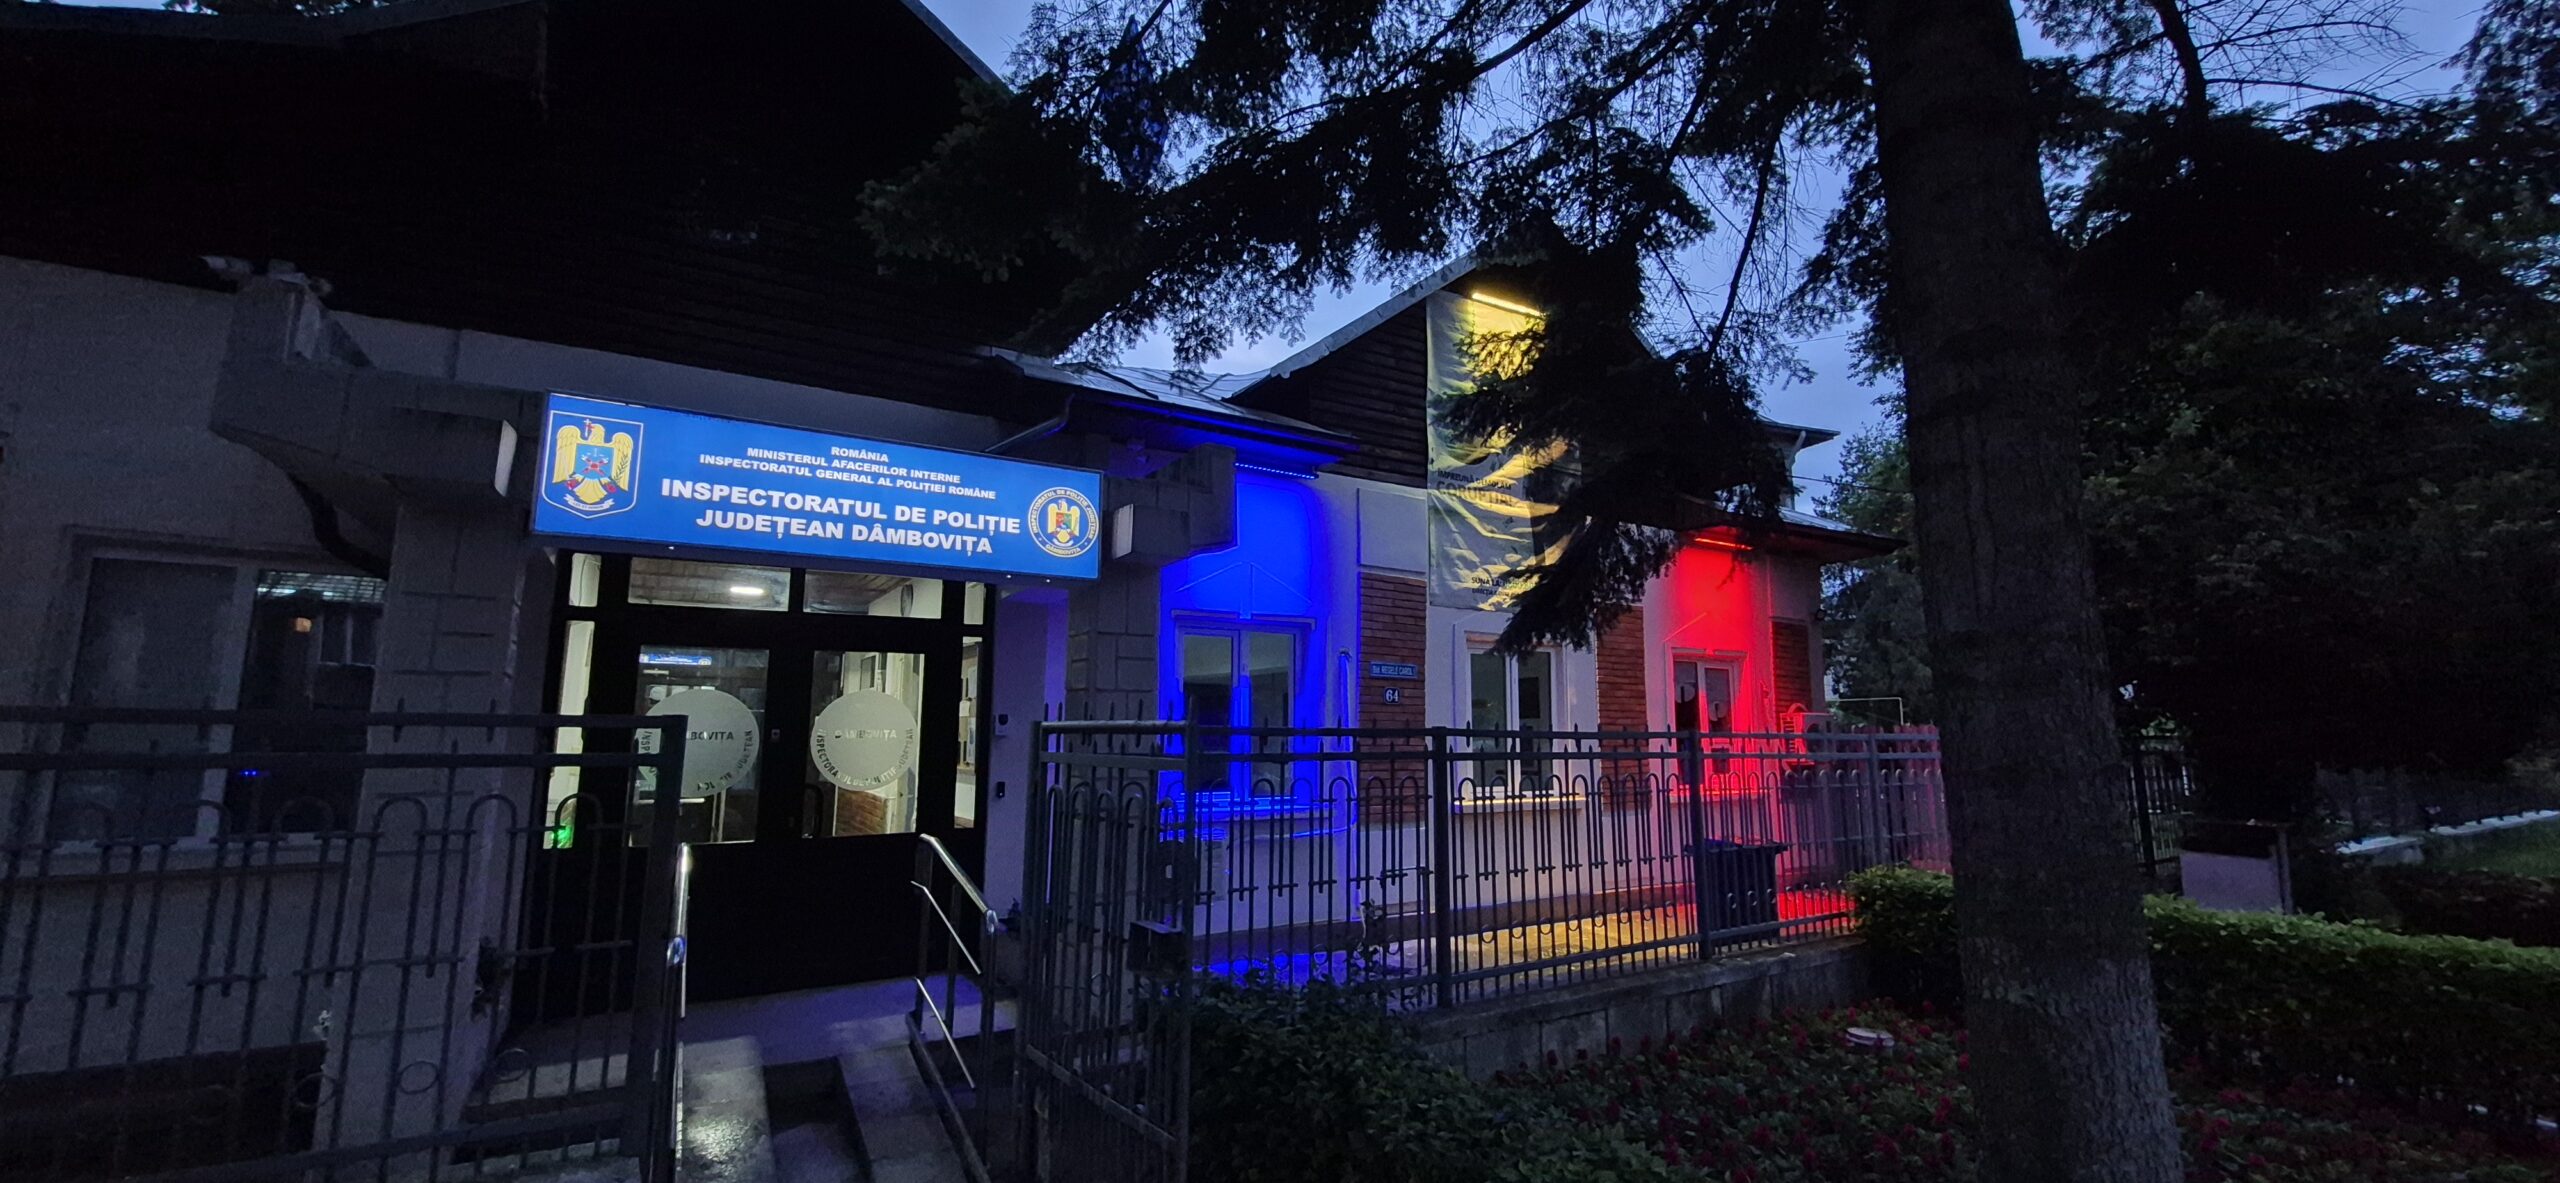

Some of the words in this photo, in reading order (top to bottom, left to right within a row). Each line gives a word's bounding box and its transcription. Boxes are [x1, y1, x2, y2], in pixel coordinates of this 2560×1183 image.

[747, 447, 828, 466] MINISTERUL
[831, 459, 908, 477] AFACERILOR
[910, 469, 961, 483] INTERNE
[831, 446, 889, 462] ROMÂNIA
[700, 454, 812, 477] INSPECTORATUL
[816, 469, 874, 484] GENERAL
[877, 477, 893, 487] AL
[896, 479, 945, 493] POLIȚIEI
[948, 486, 996, 499] ROMÂNE
[661, 478, 887, 520] INSPECTORATUL
[895, 505, 926, 523] DE
[933, 509, 1020, 536] POLIȚIE
[1030, 490, 1056, 534] INSPECTORATUL
[696, 509, 844, 539] JUDEȚEAN
[852, 523, 993, 557] DÂMBOVIȚA
[1386, 689, 1399, 702] 64
